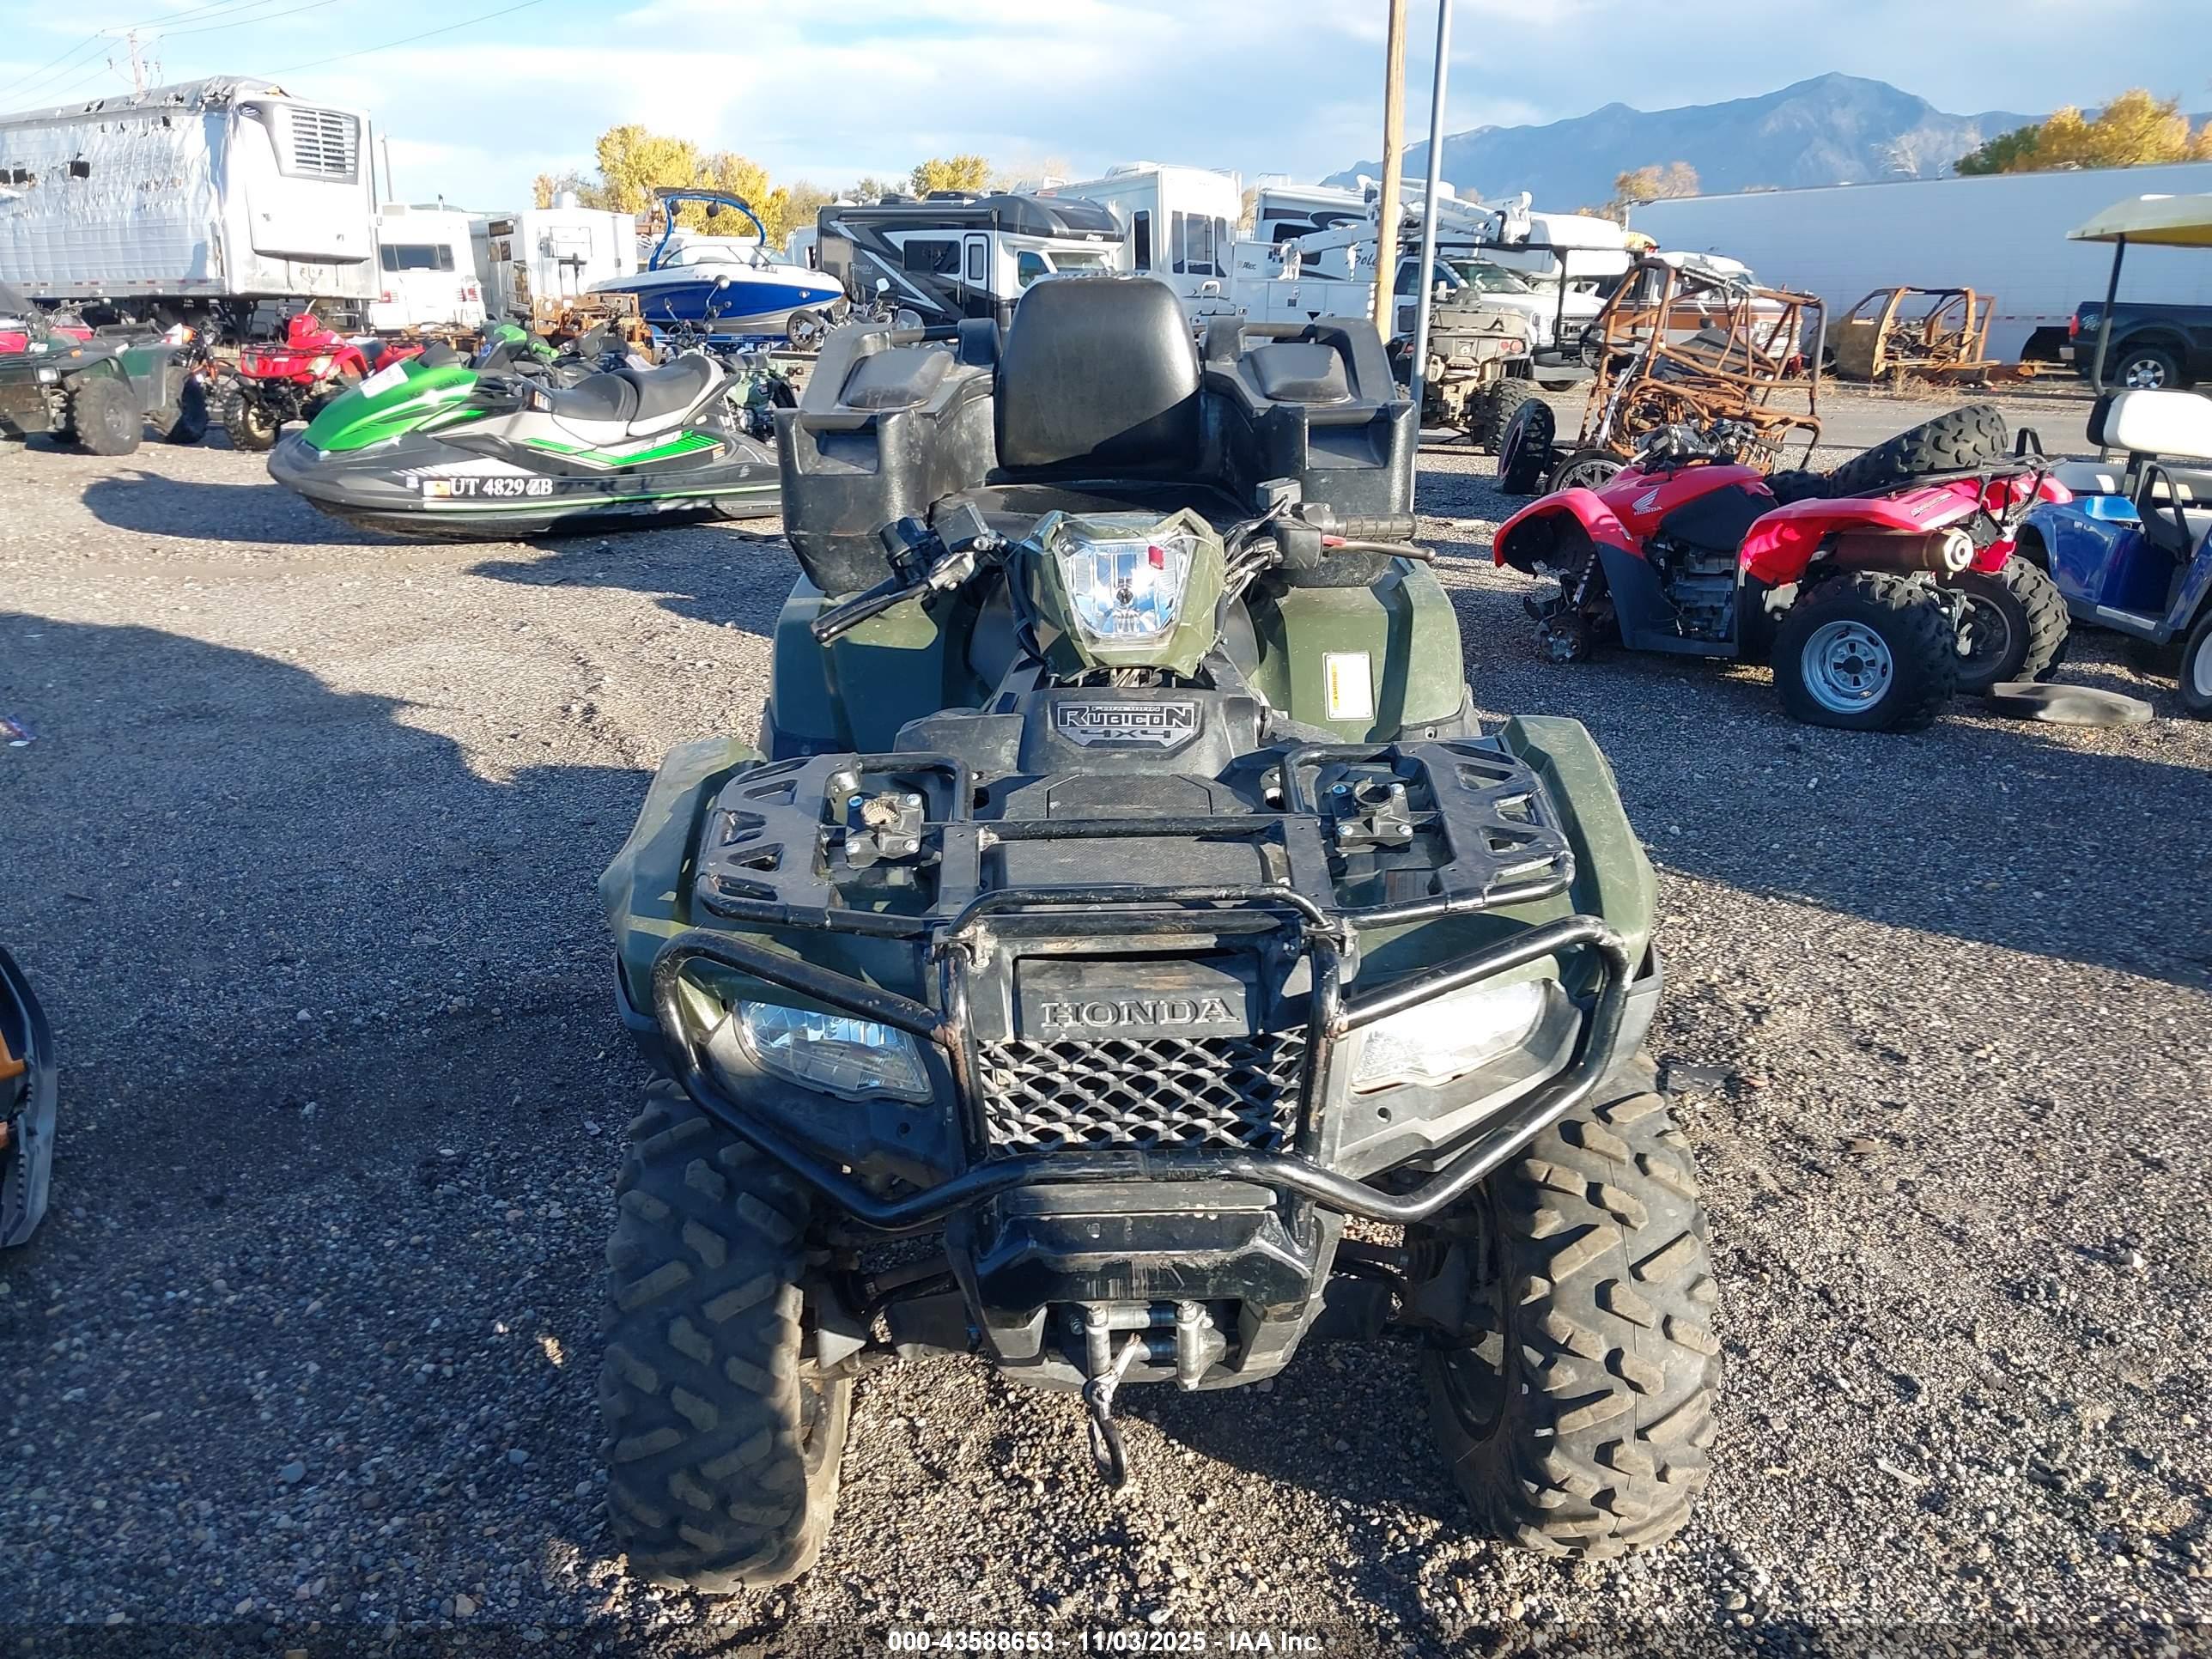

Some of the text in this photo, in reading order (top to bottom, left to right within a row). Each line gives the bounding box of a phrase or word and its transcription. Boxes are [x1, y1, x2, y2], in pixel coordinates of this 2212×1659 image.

[449, 477, 480, 495] UT
[482, 477, 526, 496] 4829
[1633, 506, 1663, 515] HONDA
[1057, 706, 1194, 728] RUBICON
[1041, 997, 1243, 1028] HONDA
